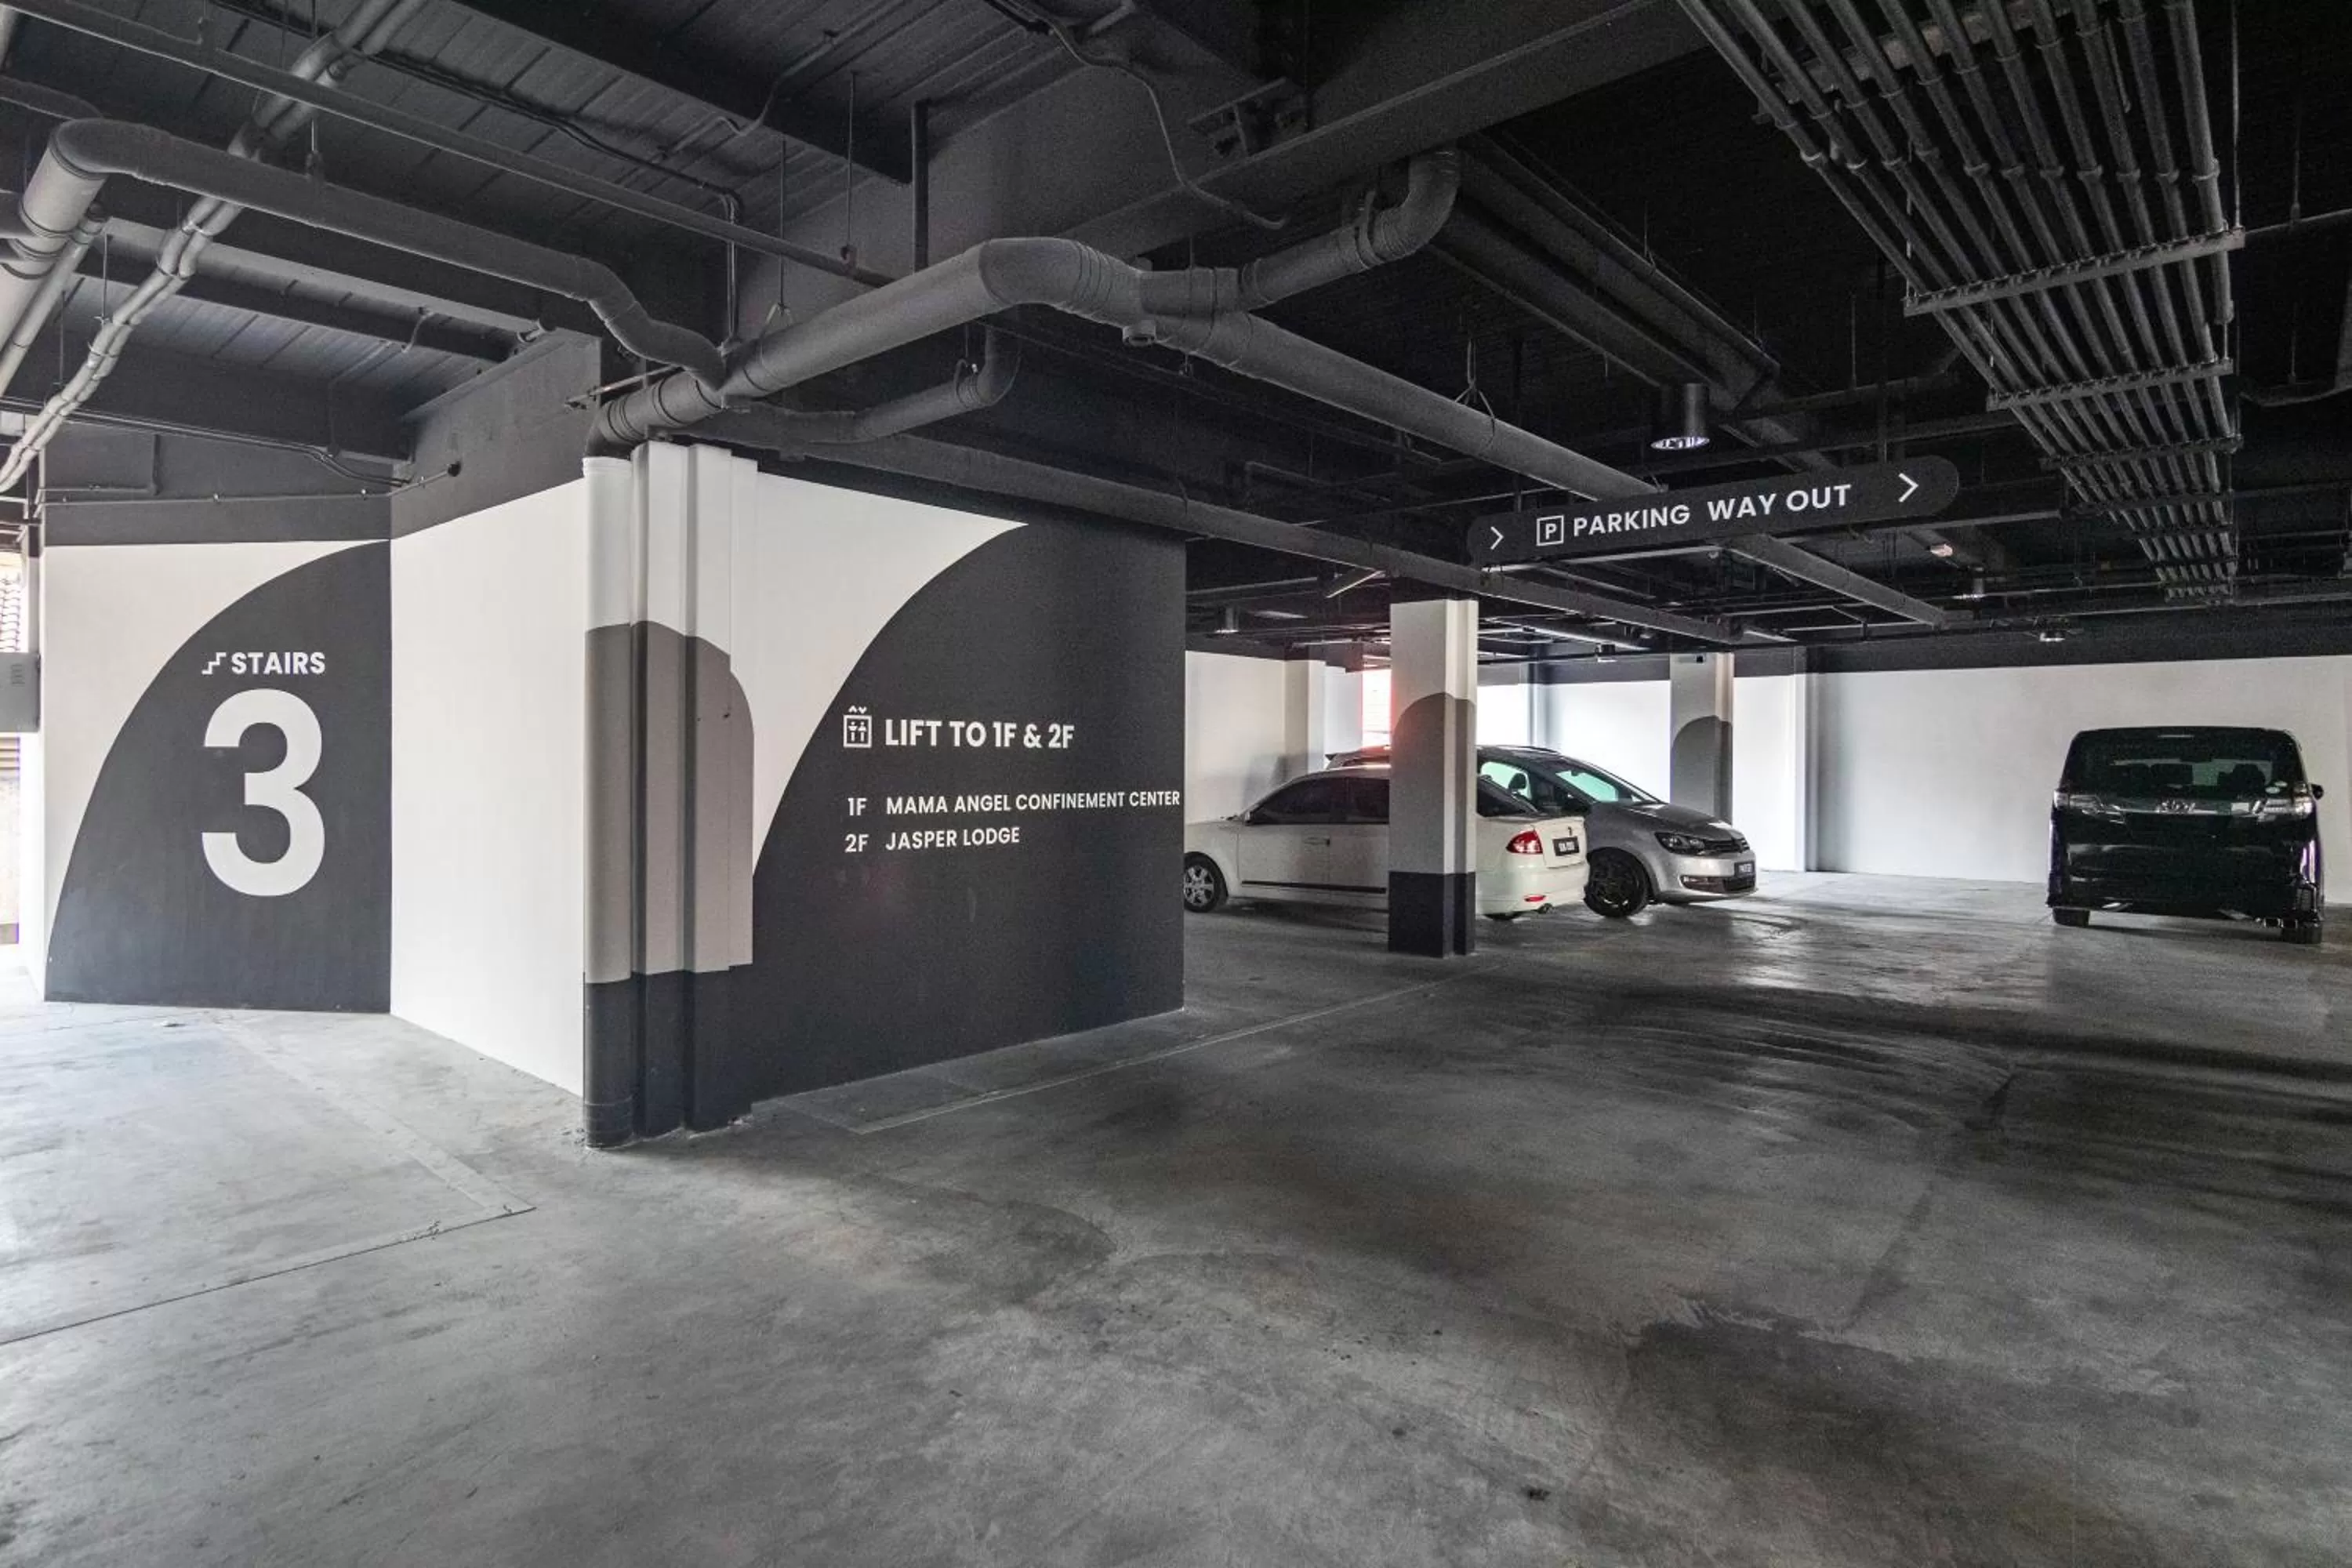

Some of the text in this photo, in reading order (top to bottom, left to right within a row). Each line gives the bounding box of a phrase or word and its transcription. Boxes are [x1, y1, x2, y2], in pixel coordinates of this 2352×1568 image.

[1545, 484, 1852, 541] P PARKING WAY OUT
[230, 652, 326, 676] STAIRS
[885, 718, 1075, 749] LIFT TO 1F & 2F
[201, 688, 325, 897] 3
[847, 790, 1181, 817] 1F MAMA ANGEL CONFINEMENT CENTER
[844, 826, 1021, 853] 2F JASPER LODGE
